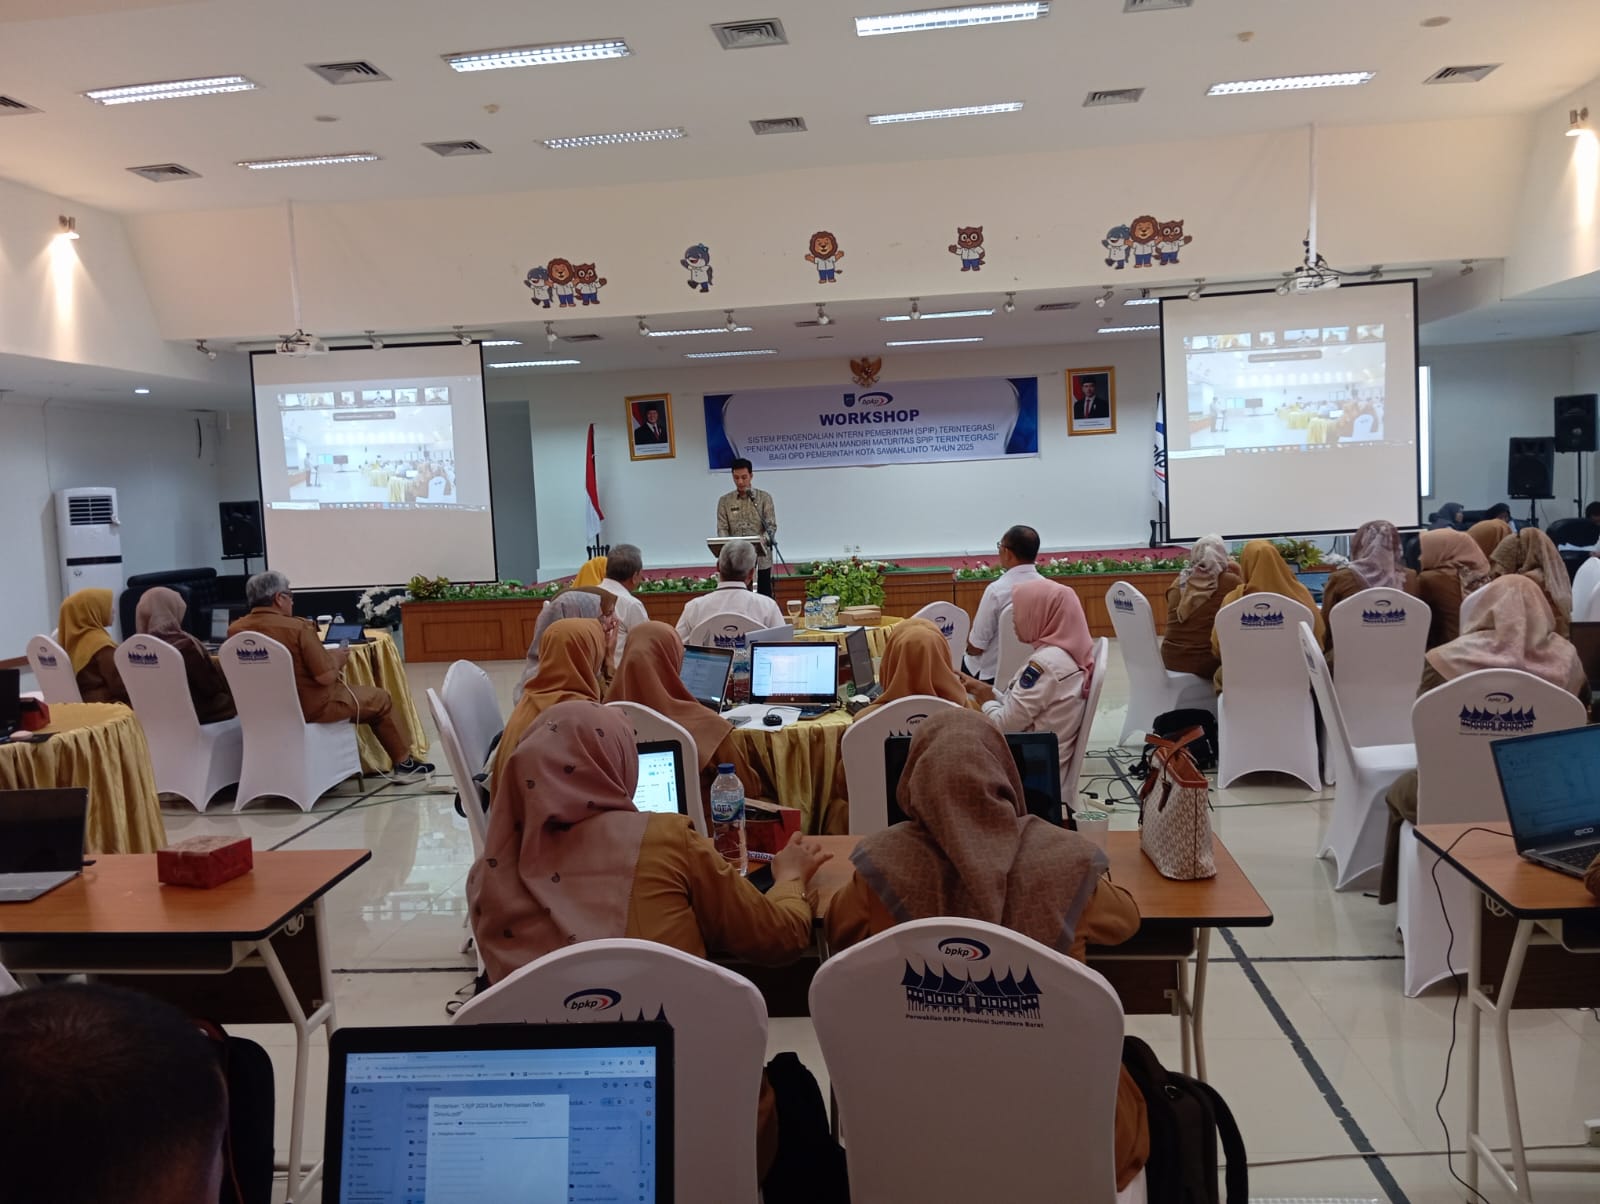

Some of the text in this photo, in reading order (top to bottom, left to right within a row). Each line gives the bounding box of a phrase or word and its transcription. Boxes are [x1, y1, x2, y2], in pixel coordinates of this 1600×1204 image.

[819, 410, 920, 426] WORKSHOP
[747, 424, 995, 444] SISTEM PENGENDALIAN INTERN PEMERINTAH (SPIP) TERINTEGRASI
[800, 440, 838, 450] PENILAIAN
[840, 438, 871, 448] MANDIRI
[872, 436, 915, 446] MATURITAS
[916, 436, 933, 444] SPIP
[768, 452, 787, 460] BAGI
[788, 452, 805, 460] OPD
[806, 450, 854, 458] PEMERINTAH
[855, 448, 875, 456] KOTA
[876, 446, 928, 454] SAWAHLUNTO
[930, 444, 956, 452] TAHUN
[944, 946, 970, 958] bpkp
[570, 999, 598, 1011] bpkp
[905, 1013, 943, 1022] Perwakilan
[944, 1015, 962, 1023] BPKP
[991, 1019, 1024, 1028] Sumatera
[1025, 1021, 1044, 1029] Barat
